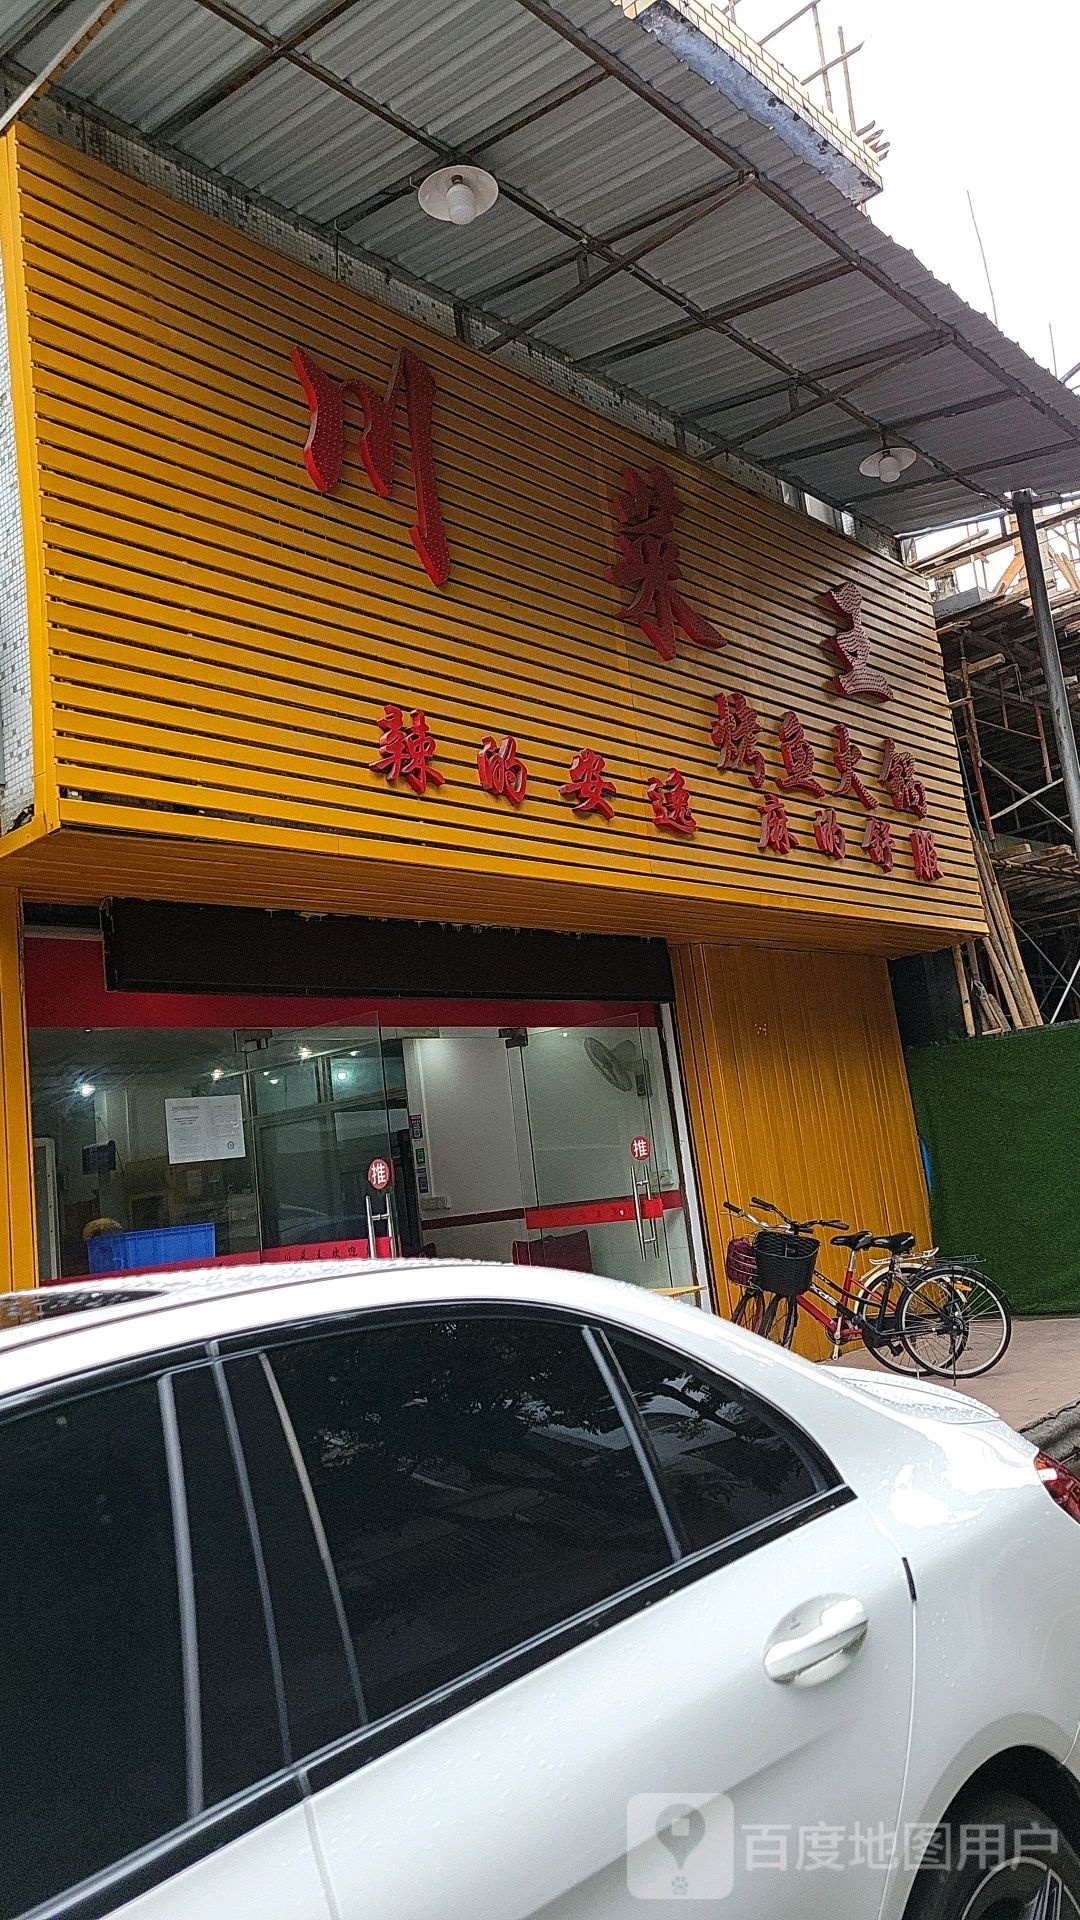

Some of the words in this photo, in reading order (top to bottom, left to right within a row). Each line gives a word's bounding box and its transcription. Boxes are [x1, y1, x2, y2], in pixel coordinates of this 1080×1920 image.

[291, 345, 895, 703] 川菜王
[369, 704, 698, 834] 辣的安逸
[371, 1162, 387, 1185] 推
[632, 1138, 649, 1158] 推
